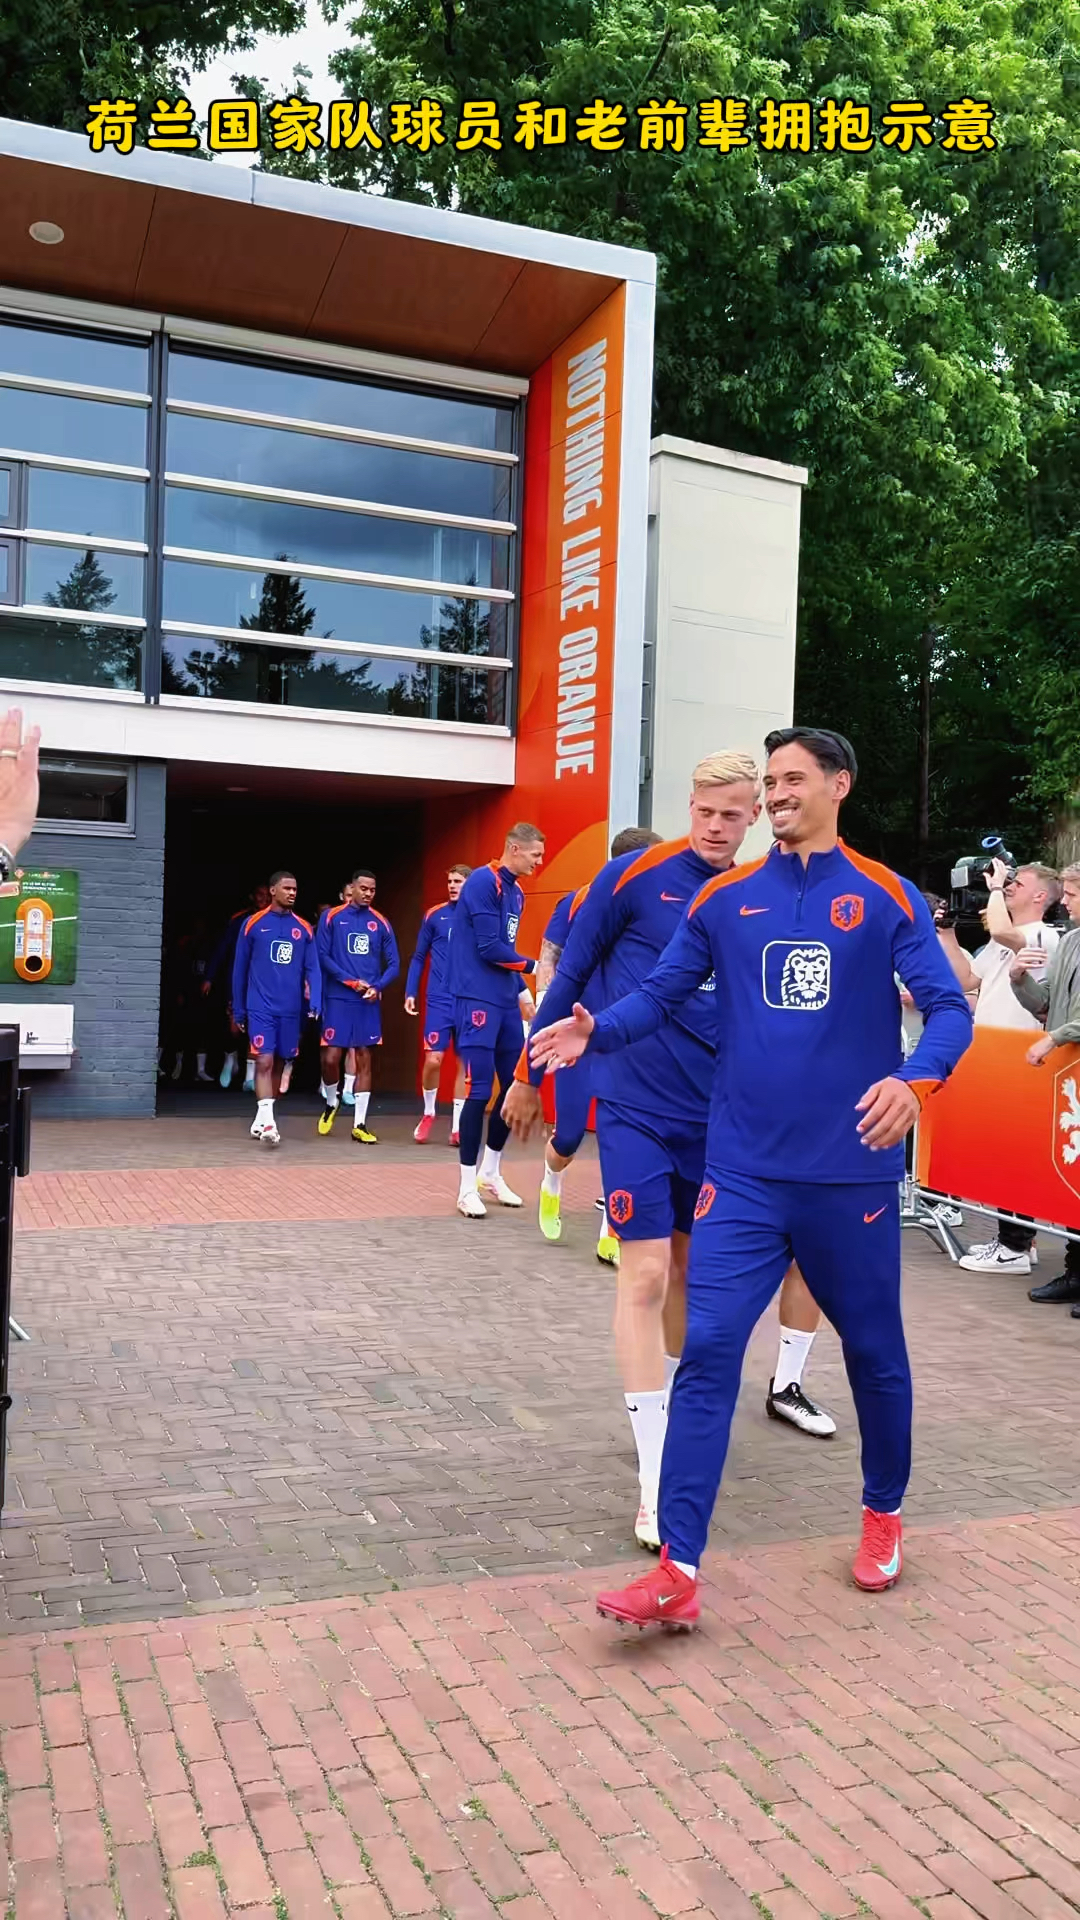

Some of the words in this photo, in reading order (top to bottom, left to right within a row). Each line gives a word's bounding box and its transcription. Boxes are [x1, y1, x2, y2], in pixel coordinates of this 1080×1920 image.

[563, 338, 607, 526] NOTHING
[560, 526, 601, 621] LIKE
[555, 626, 598, 780] ORANJE
